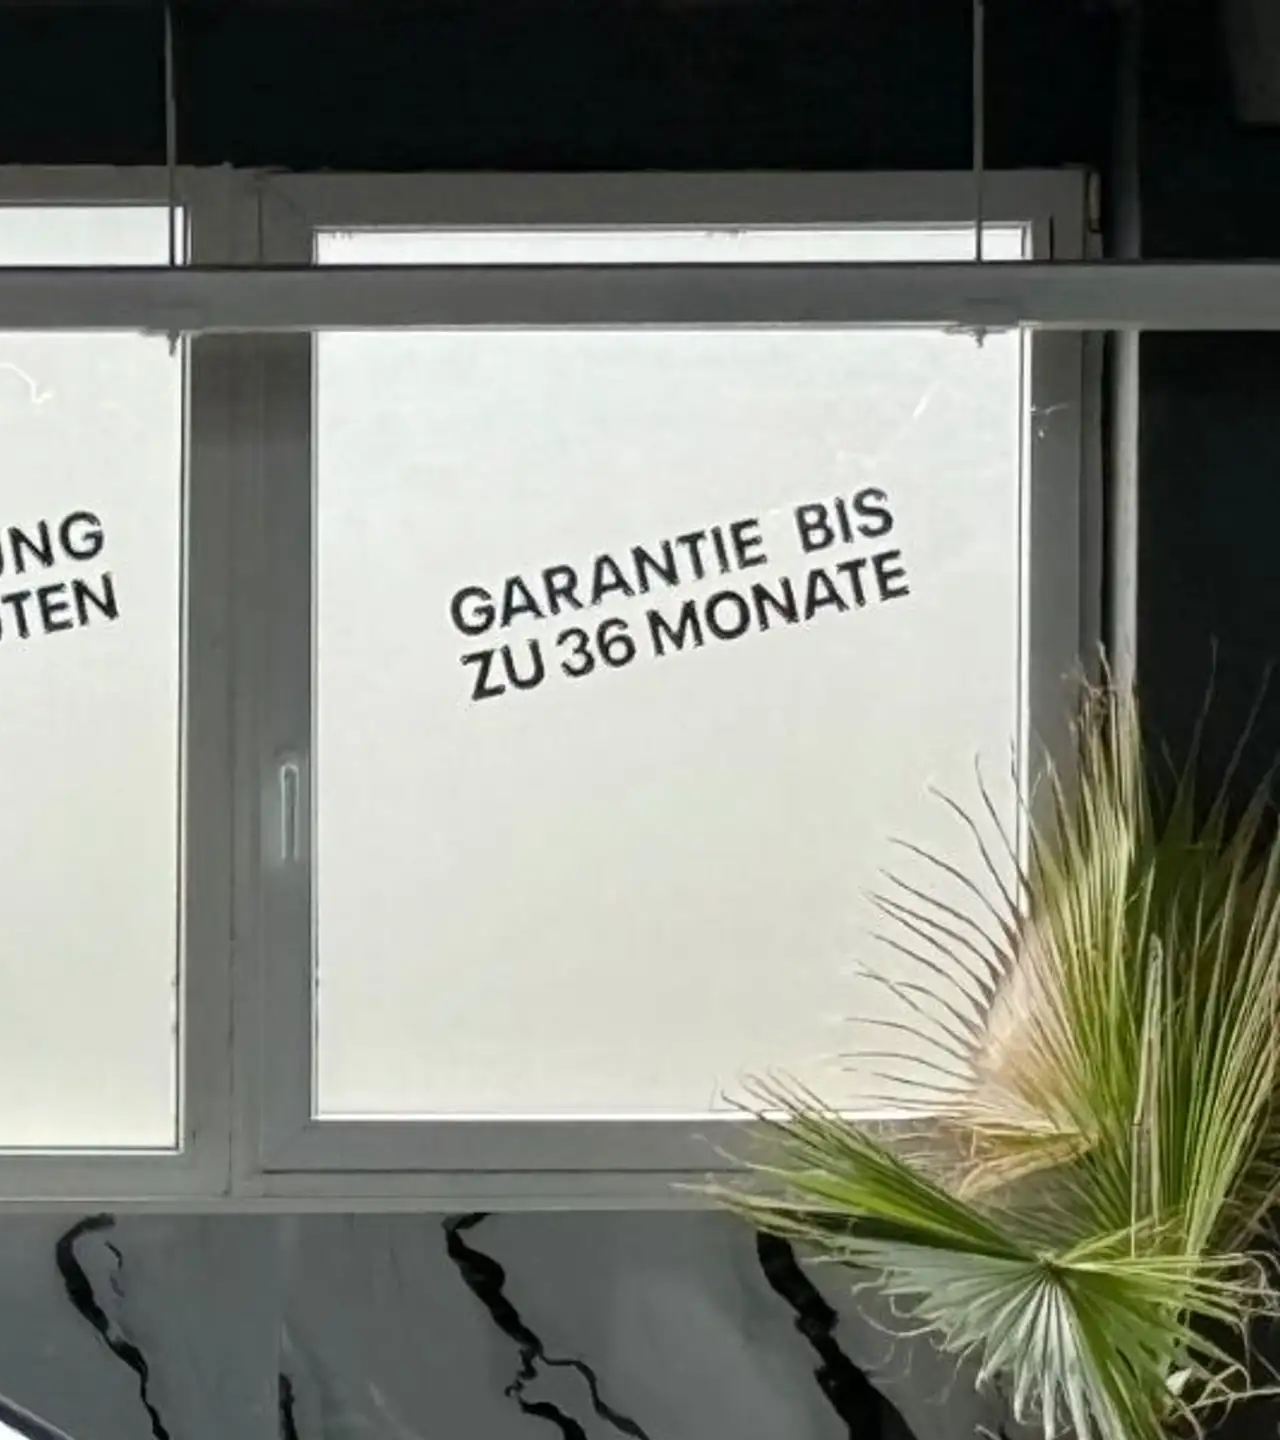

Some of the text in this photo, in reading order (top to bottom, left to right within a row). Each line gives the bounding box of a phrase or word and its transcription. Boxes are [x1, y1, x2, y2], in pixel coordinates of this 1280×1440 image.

[449, 486, 895, 637] GARANTIE BIS
[460, 548, 911, 702] ZU 36 MONATE
